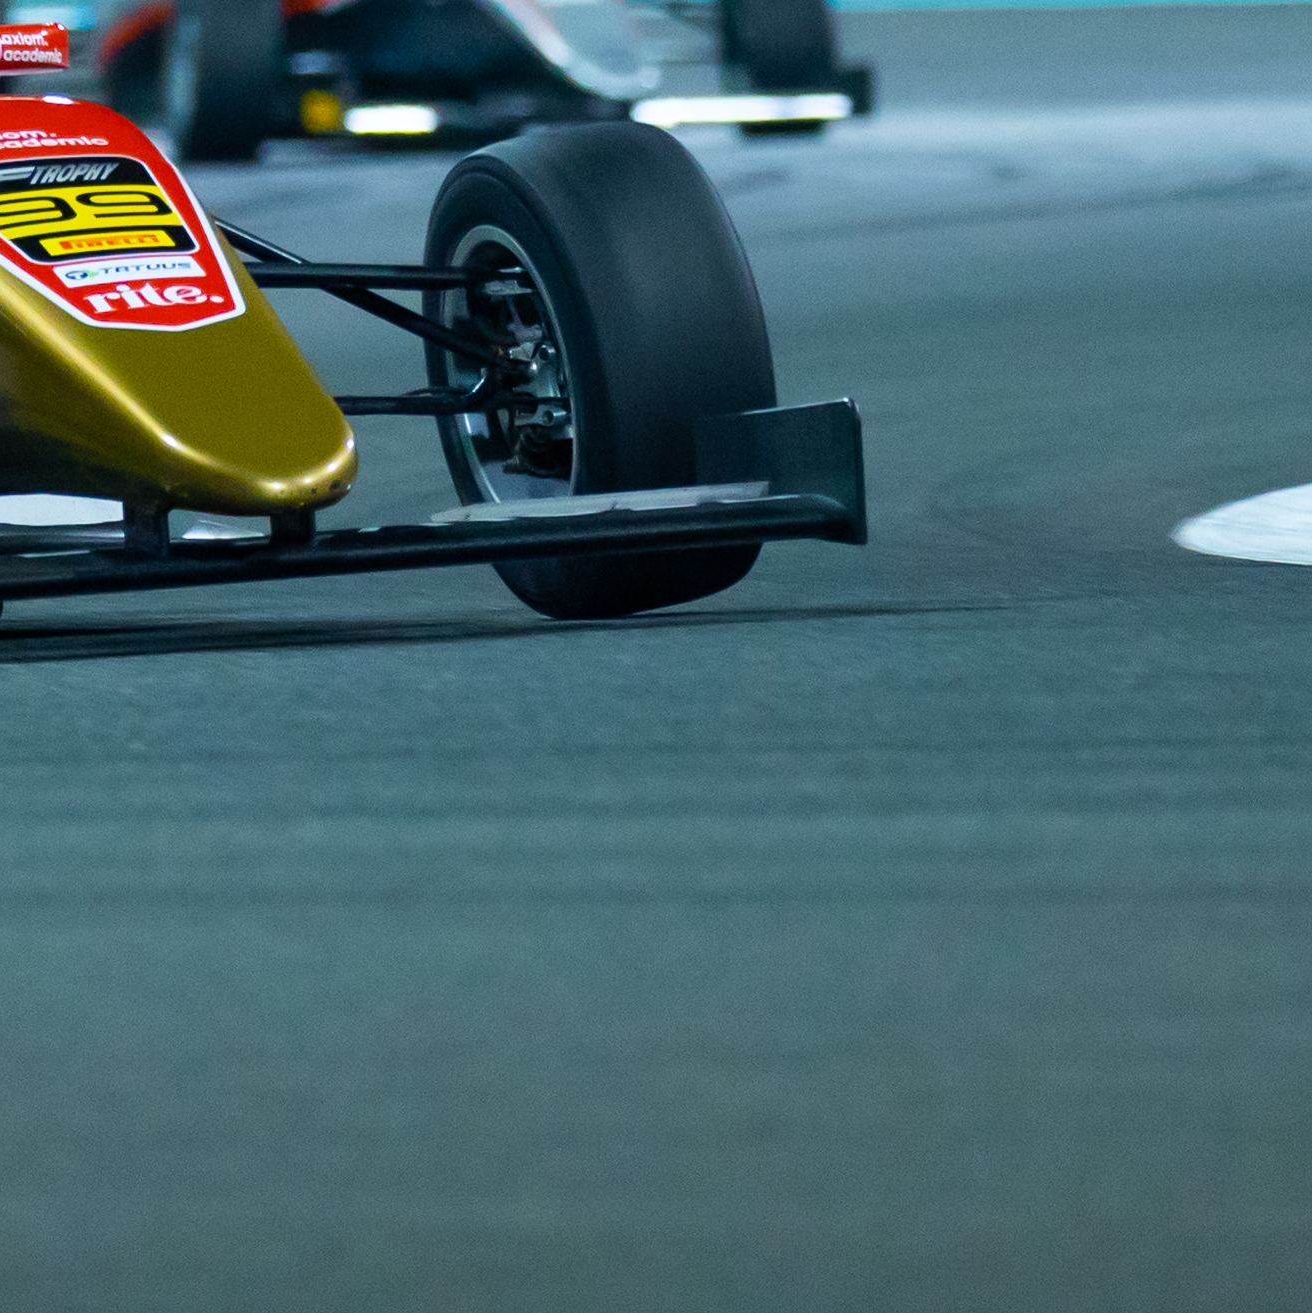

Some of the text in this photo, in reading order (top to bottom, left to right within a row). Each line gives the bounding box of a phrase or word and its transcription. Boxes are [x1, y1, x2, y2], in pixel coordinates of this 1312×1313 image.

[3, 48, 63, 64] academic
[29, 162, 120, 185] TROPHY
[58, 234, 161, 251] PIRELLI
